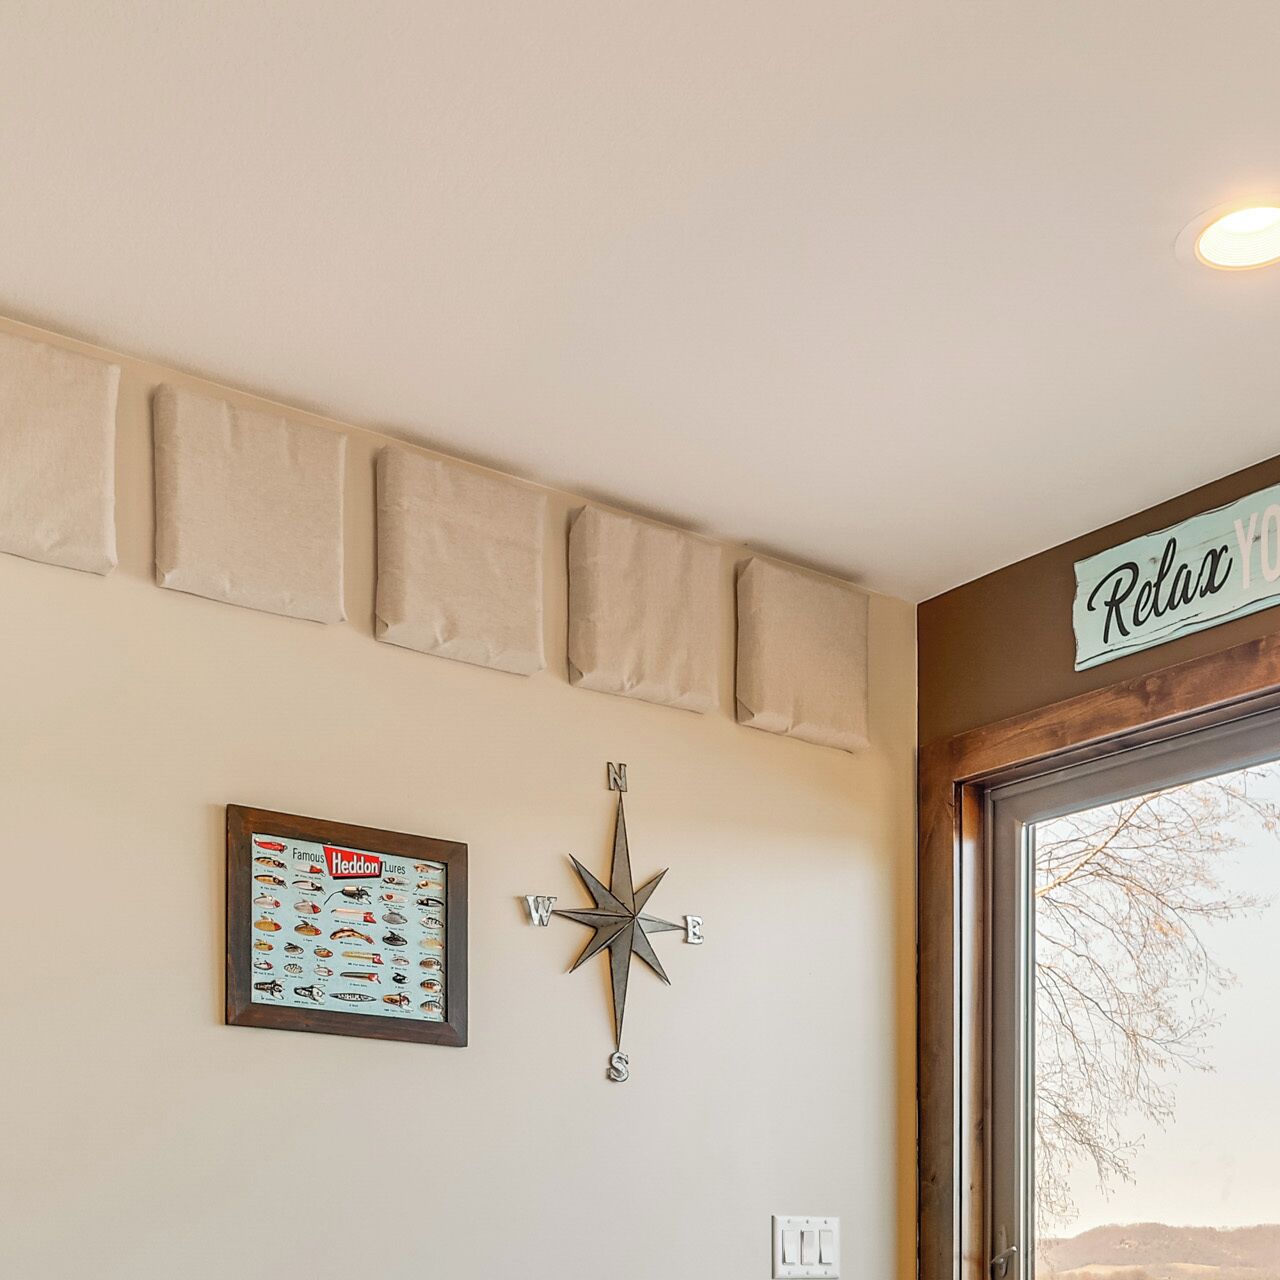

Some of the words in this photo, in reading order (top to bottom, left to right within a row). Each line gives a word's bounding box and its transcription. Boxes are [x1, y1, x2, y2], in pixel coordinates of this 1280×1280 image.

[1086, 536, 1234, 644] Relax
[606, 761, 628, 792] N
[292, 847, 325, 864] Famous
[331, 851, 380, 874] Heddon
[383, 860, 407, 875] Lures
[524, 894, 558, 927] W
[682, 914, 705, 945] E
[605, 1050, 630, 1083] S
